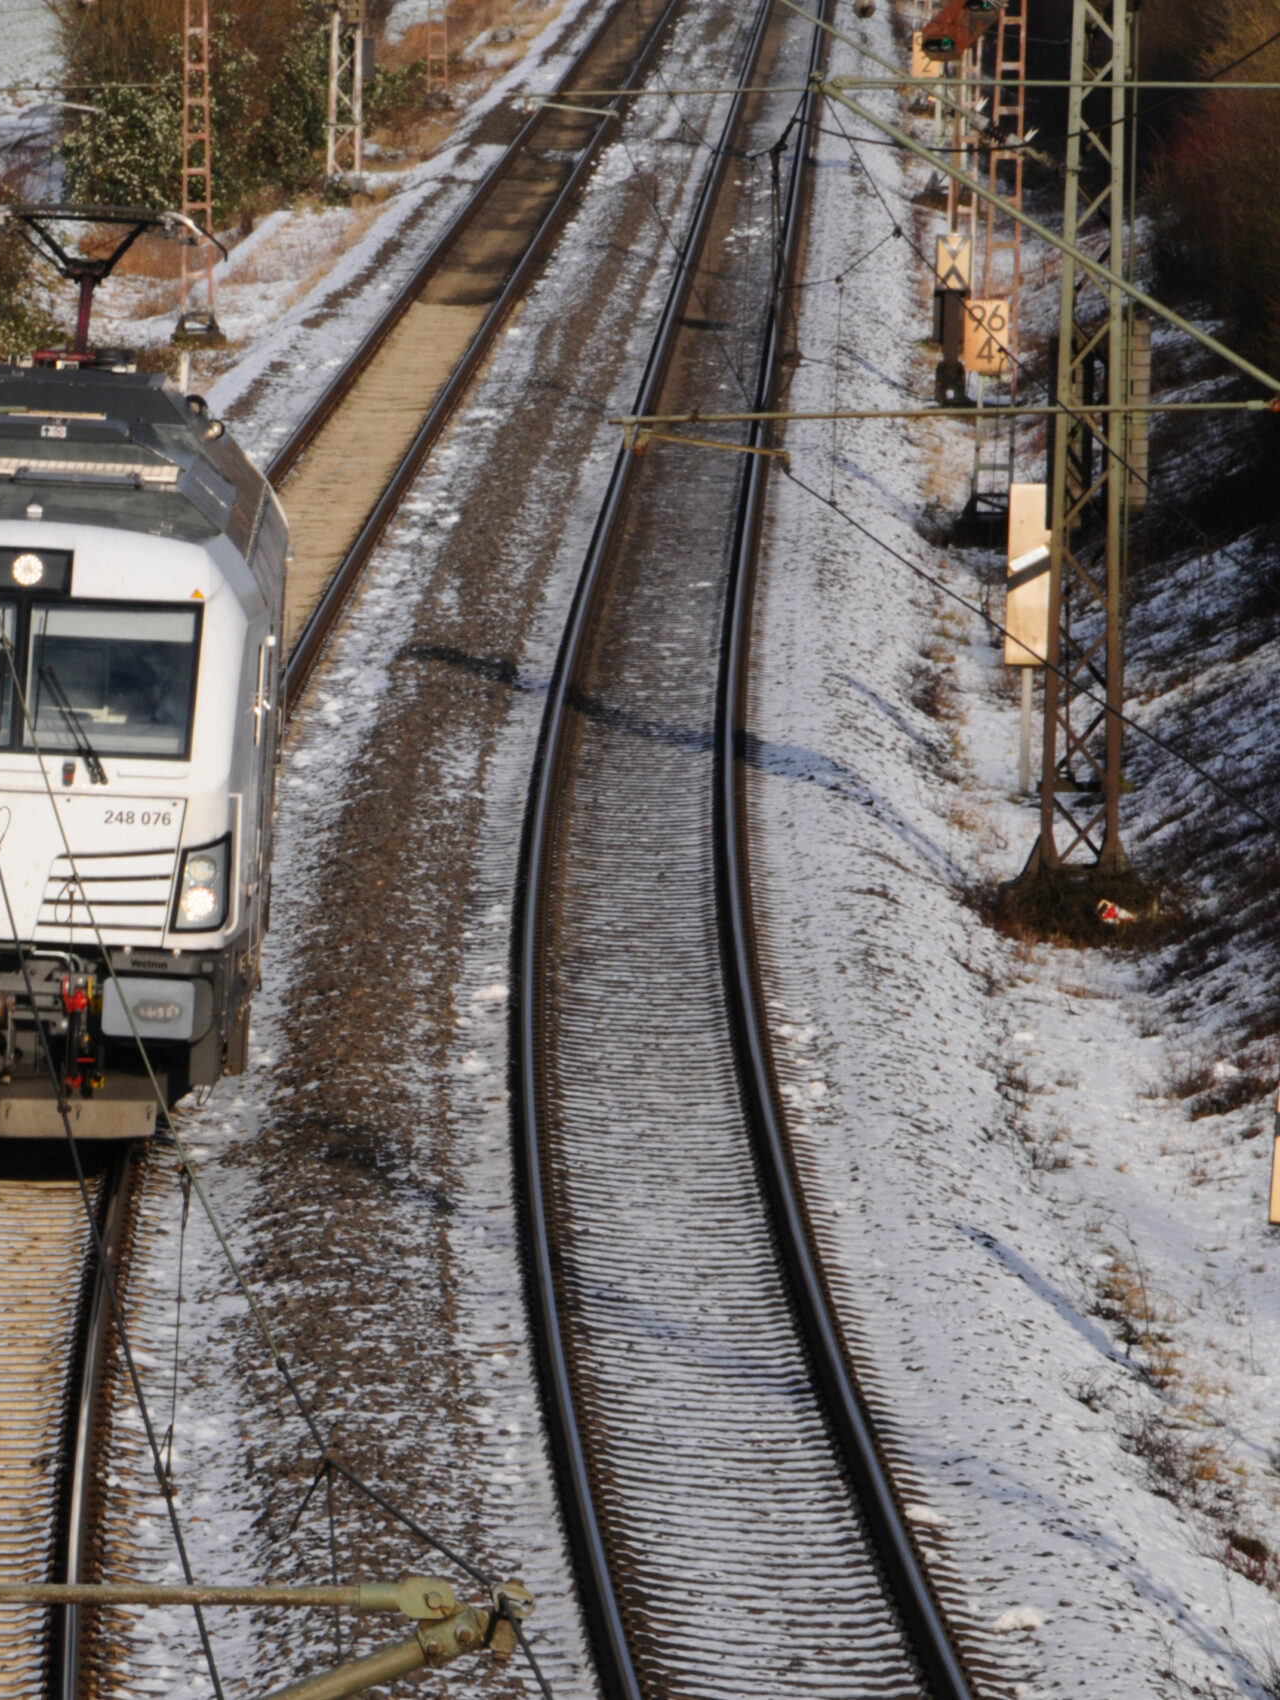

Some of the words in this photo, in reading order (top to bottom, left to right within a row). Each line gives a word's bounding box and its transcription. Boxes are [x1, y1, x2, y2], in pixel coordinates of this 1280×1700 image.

[968, 304, 1005, 333] 96
[976, 336, 995, 364] 4
[104, 810, 135, 825] 248
[141, 811, 172, 826] 076
[130, 958, 168, 970] Vectron
